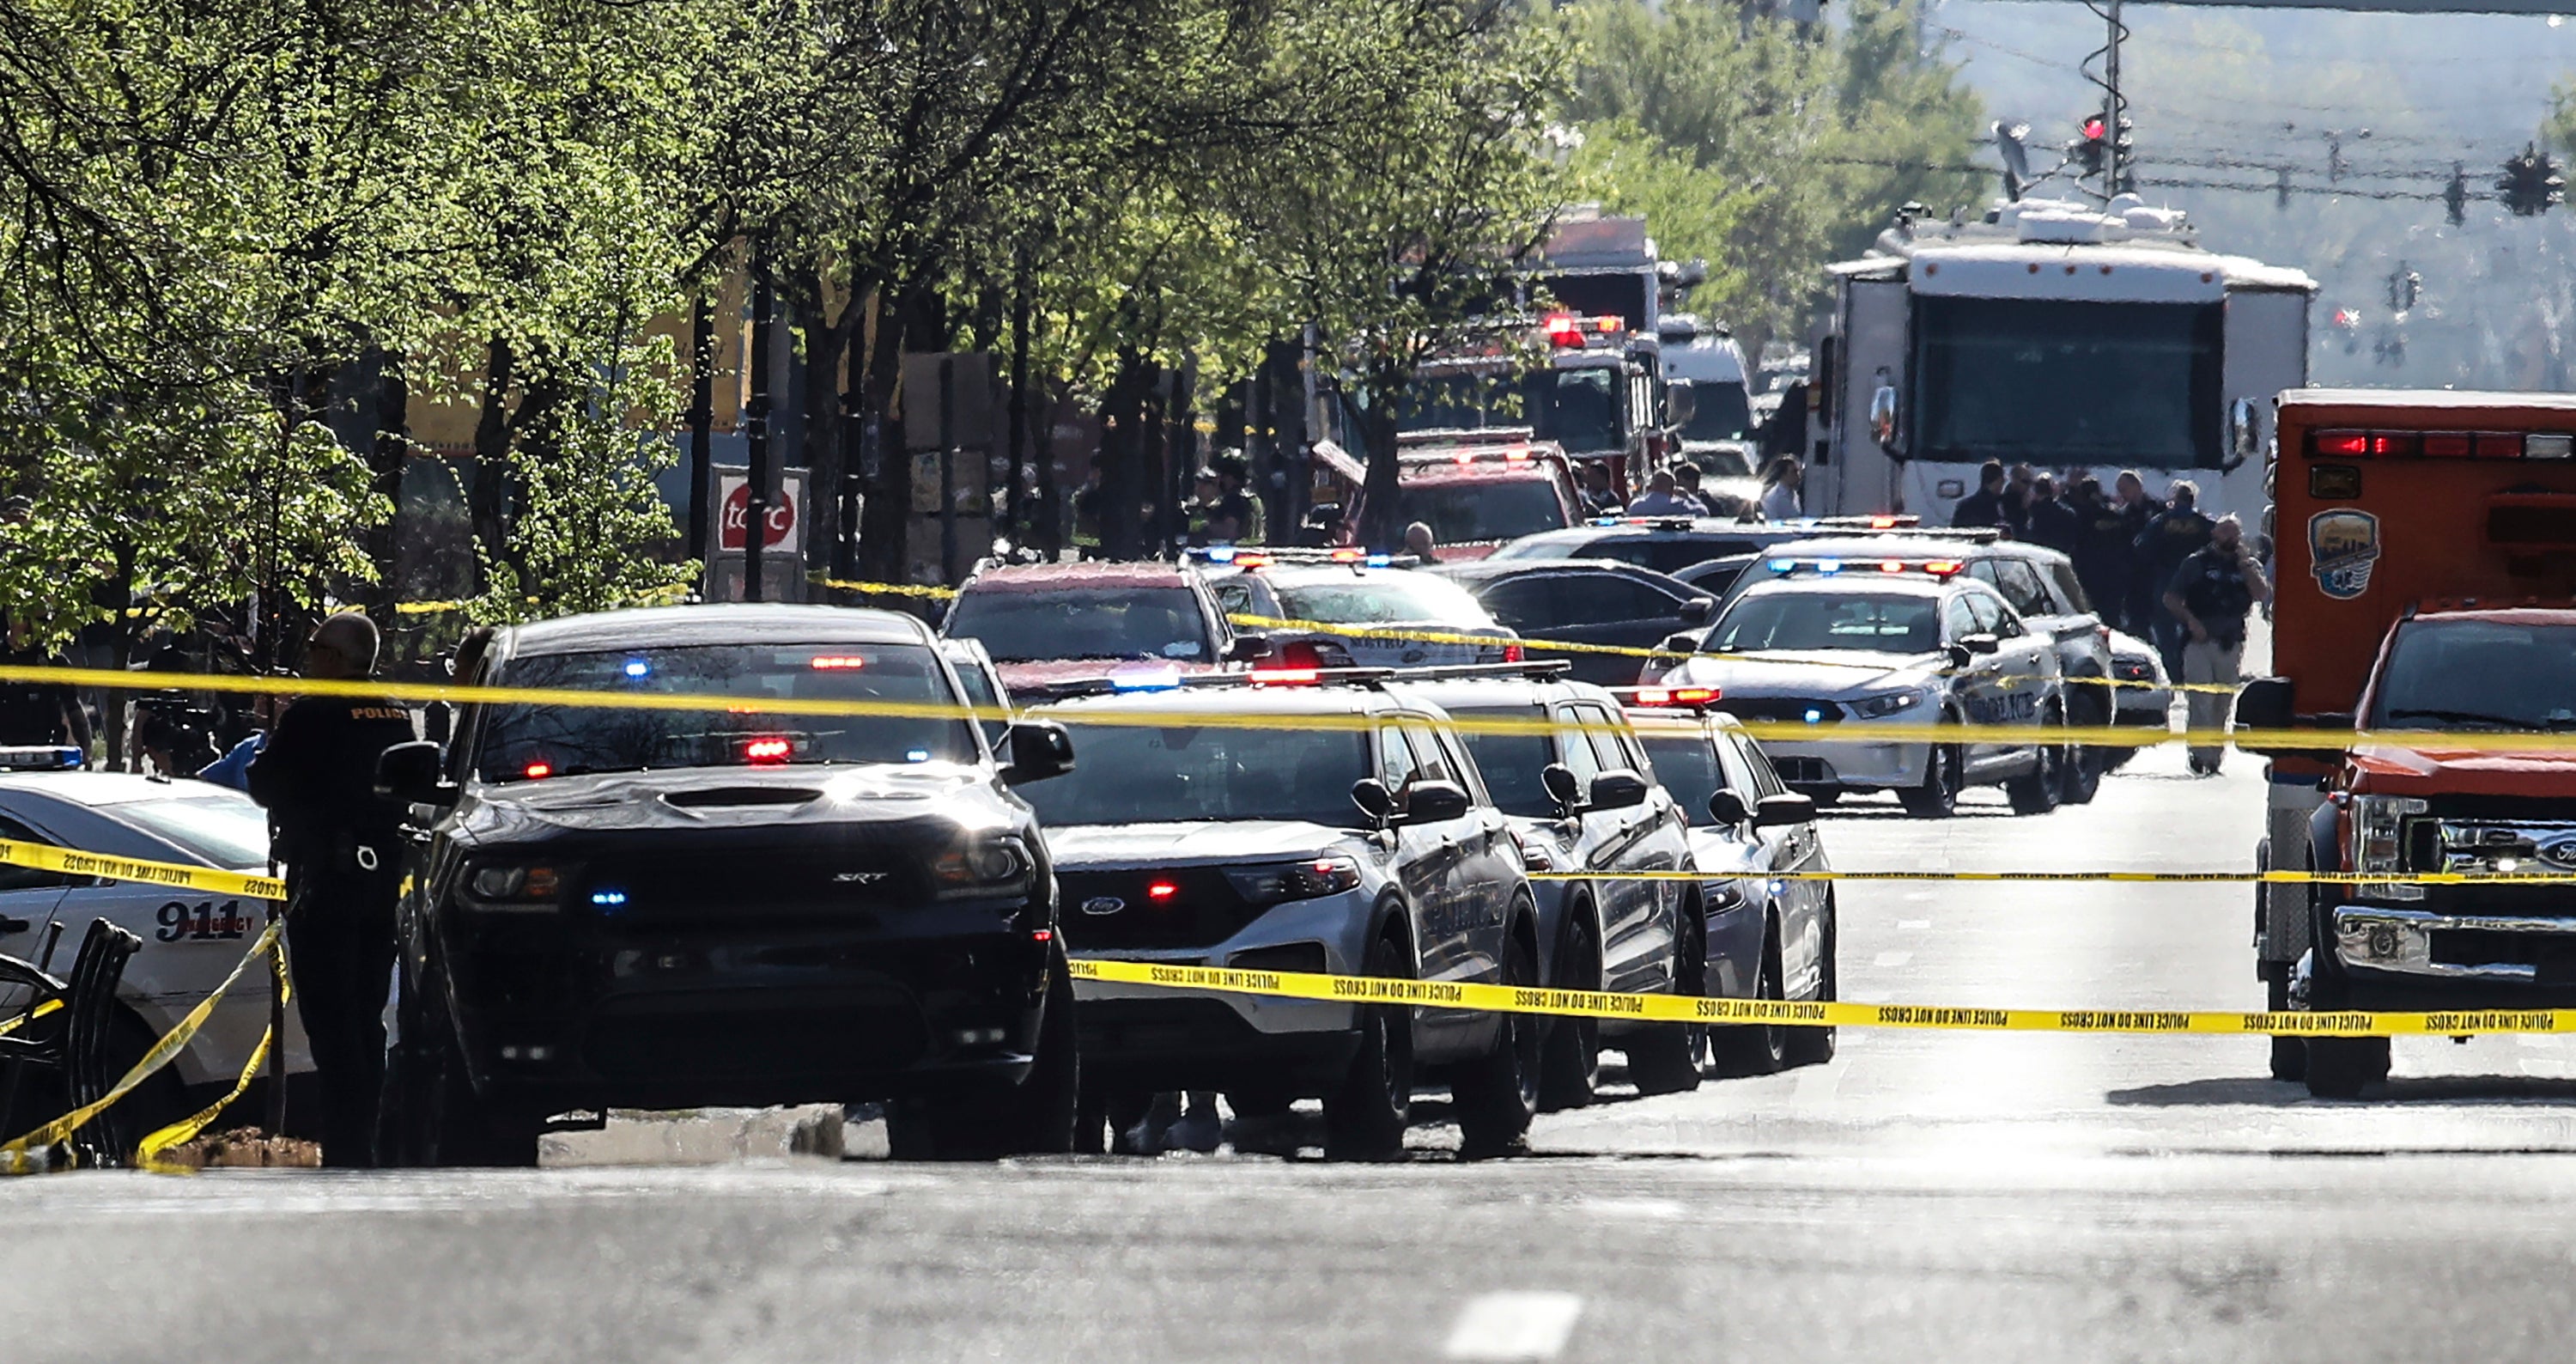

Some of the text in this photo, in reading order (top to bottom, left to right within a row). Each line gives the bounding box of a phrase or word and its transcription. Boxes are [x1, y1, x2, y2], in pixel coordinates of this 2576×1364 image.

[728, 502, 786, 529] tc
[832, 873, 888, 884] SRT
[156, 900, 242, 942] 911
[1069, 963, 1098, 976] POLIC
[1223, 971, 1243, 987] LINE
[1246, 972, 1279, 990] POLICE
[1333, 979, 1462, 1002] POLICE LINE DO NOT CROSS
[1515, 990, 1643, 1013] POLICE LINE DO NOT CROSS
[1697, 1000, 1826, 1020] POLICE LINE DO NOT CROSS
[1878, 1007, 2008, 1026] POLICE LINE DO NOT CROSS
[2061, 1013, 2190, 1029] POLICE LINE DO NOT CROSS
[2244, 1014, 2372, 1031] POLICE LINE DO NOT CROSS
[2427, 1013, 2554, 1030] POLICE LINE DO NOT CROSS
